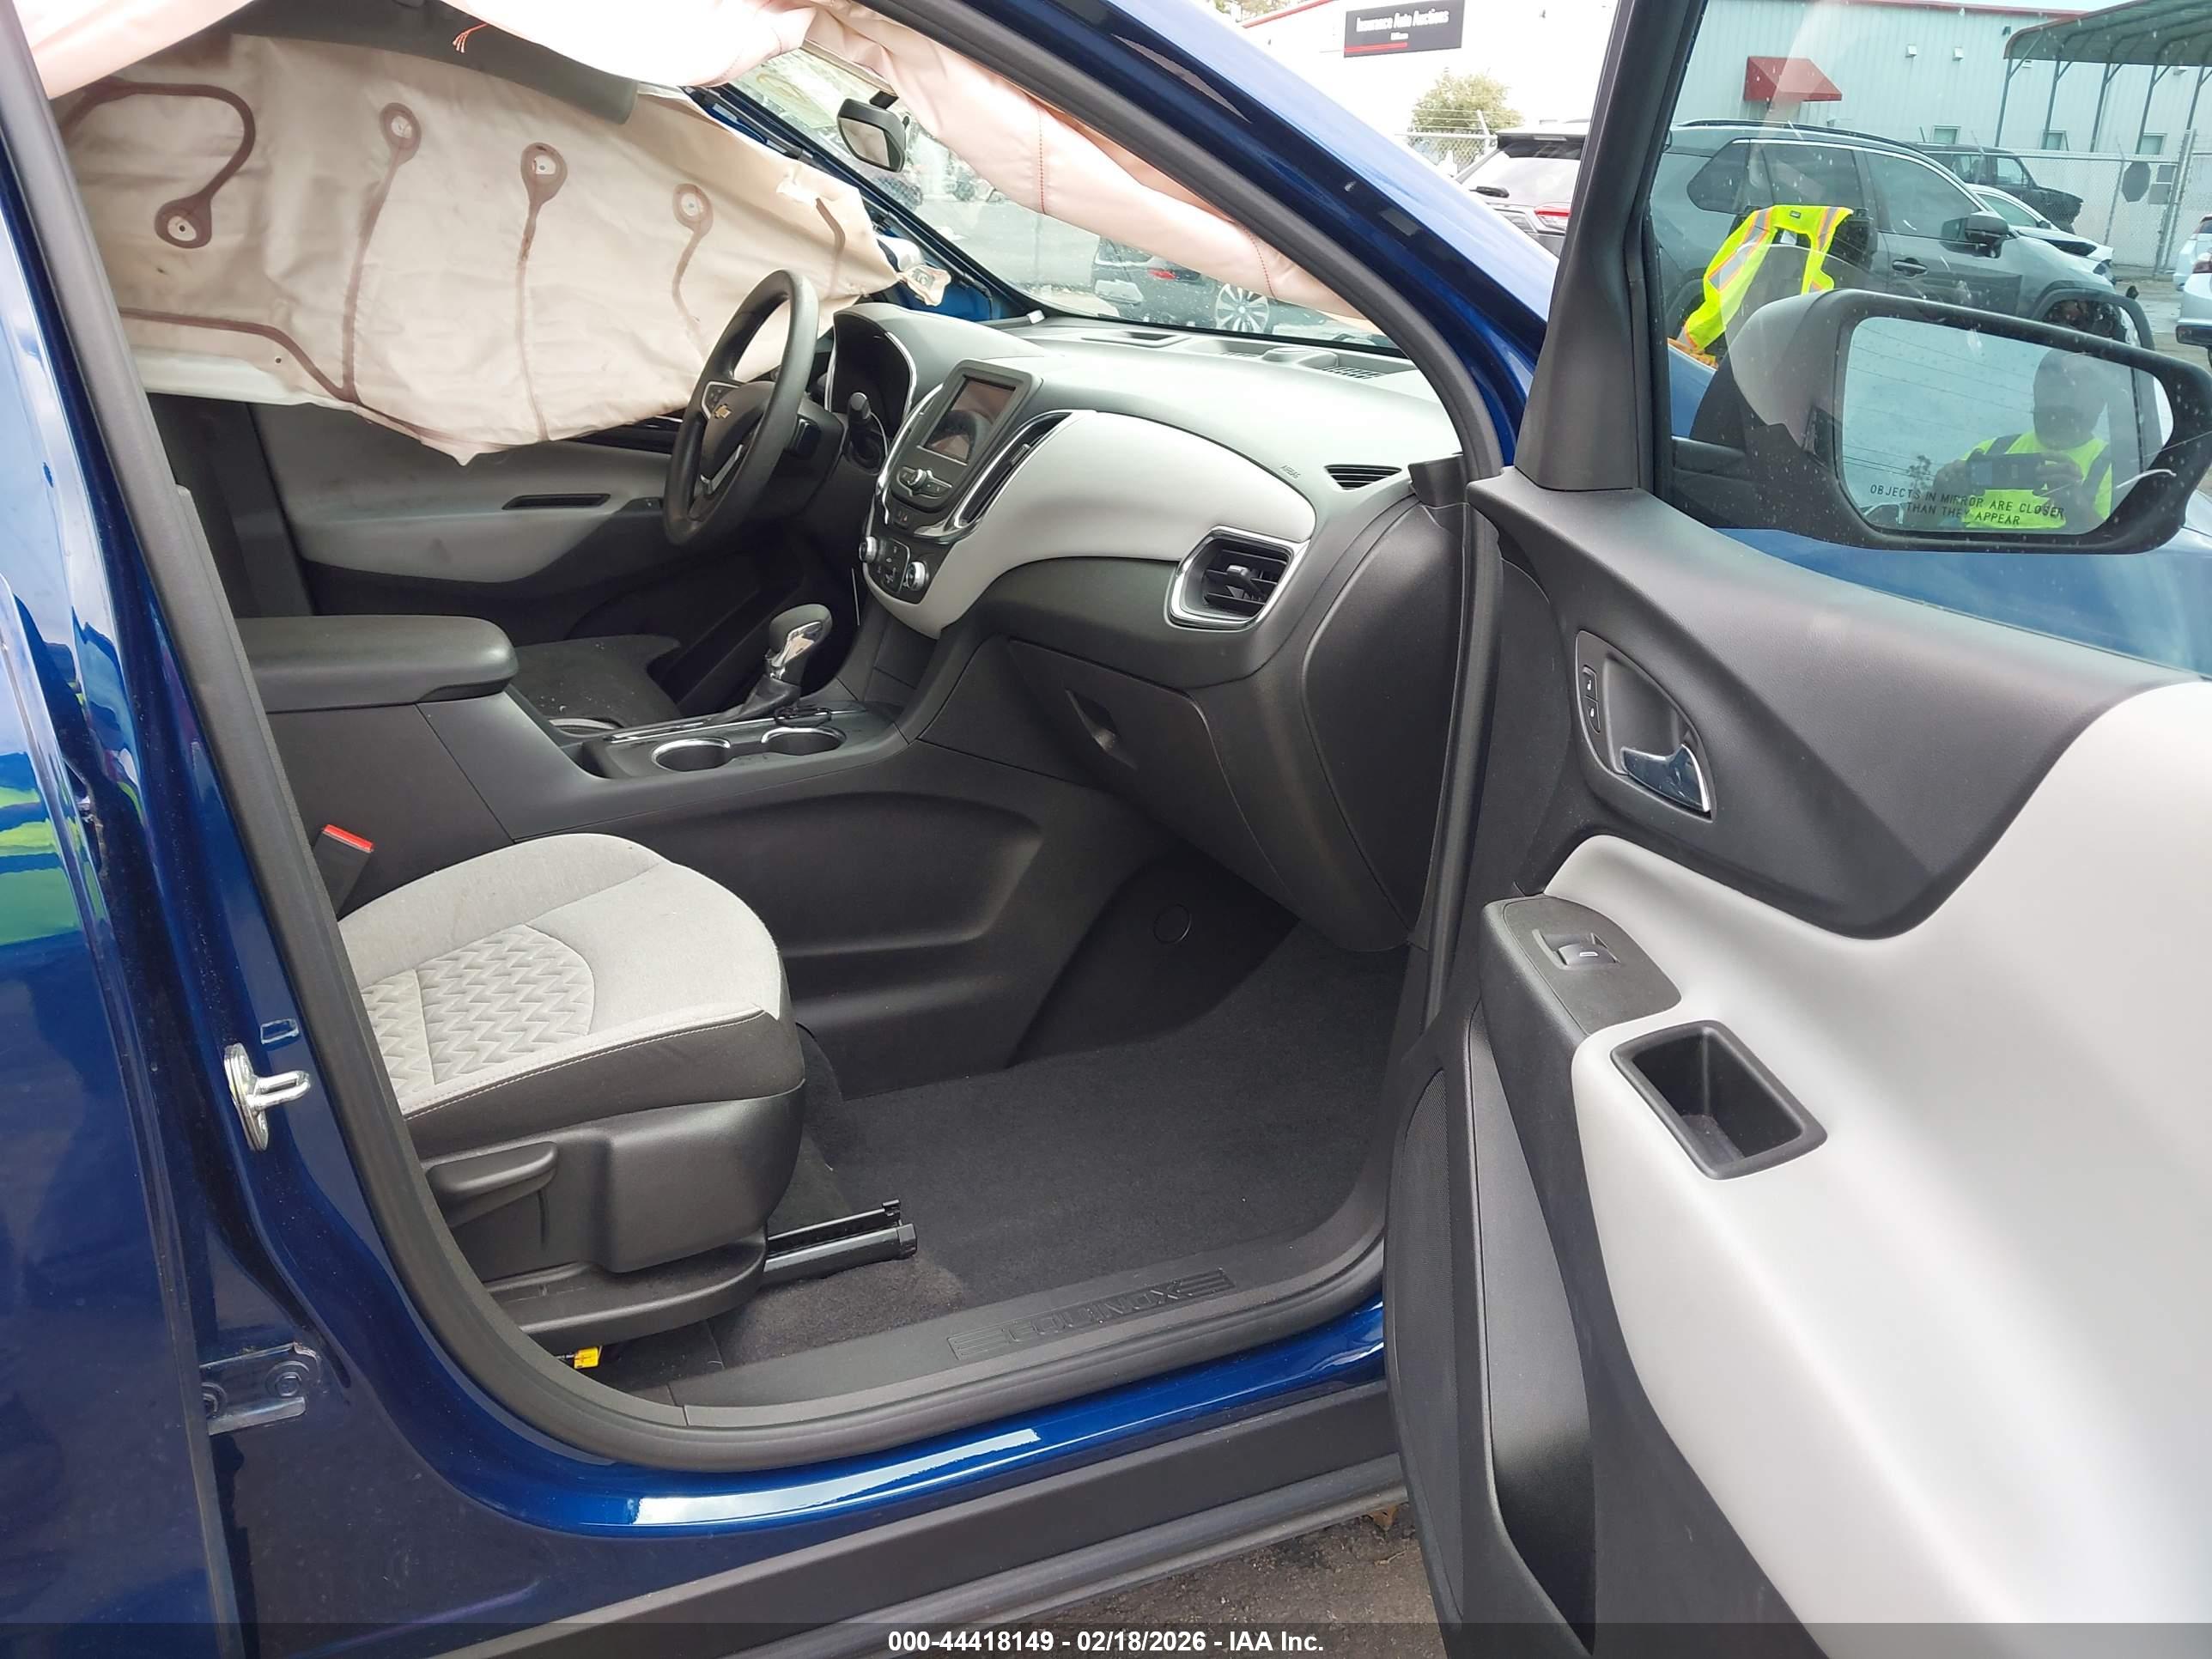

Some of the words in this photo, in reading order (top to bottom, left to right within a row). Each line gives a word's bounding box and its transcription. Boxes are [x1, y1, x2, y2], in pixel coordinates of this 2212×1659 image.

[1393, 13, 1413, 28] Auto
[1413, 8, 1449, 27] Auctions
[1870, 484, 1921, 500] OBJECTS
[1925, 491, 1937, 501] IN
[1941, 494, 1984, 507] MIRROR
[1990, 498, 2013, 511] ARE
[2020, 503, 2064, 519] CLOSER
[1907, 502, 1937, 514] THAN
[1942, 506, 1971, 518] THEY
[1975, 512, 2021, 525] APPEAR
